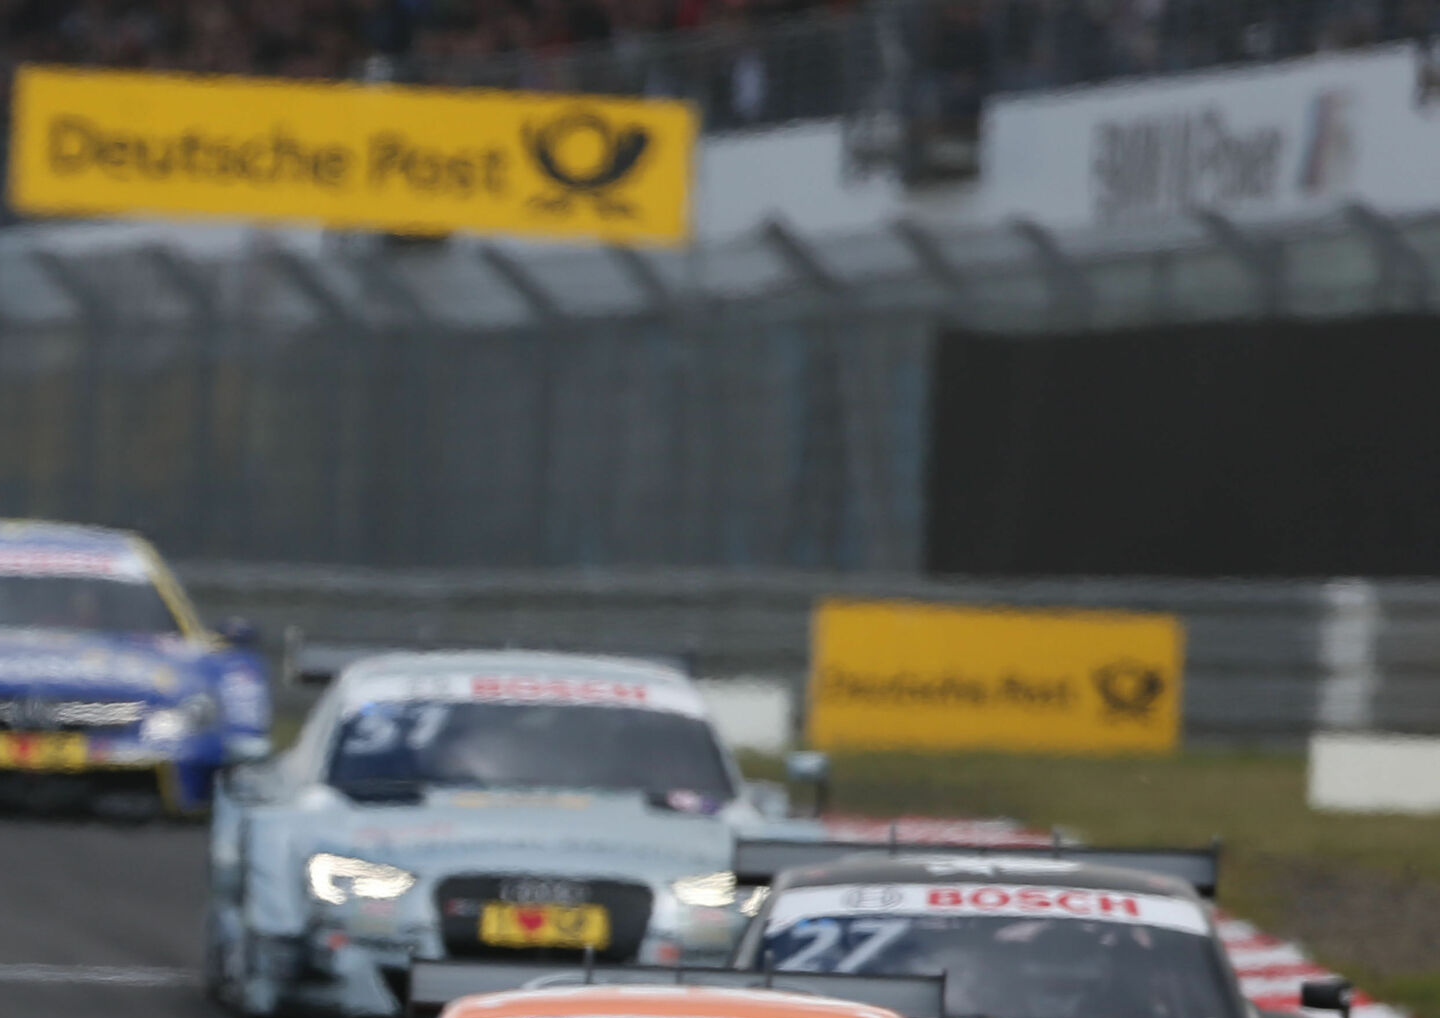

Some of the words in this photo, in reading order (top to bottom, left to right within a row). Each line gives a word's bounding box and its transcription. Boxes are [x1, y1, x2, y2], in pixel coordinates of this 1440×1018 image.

[47, 113, 350, 189] Deutsche
[367, 130, 507, 197] Post
[471, 677, 648, 703] BOSCH
[926, 886, 1142, 918] BOSCH
[775, 918, 912, 972] 27
